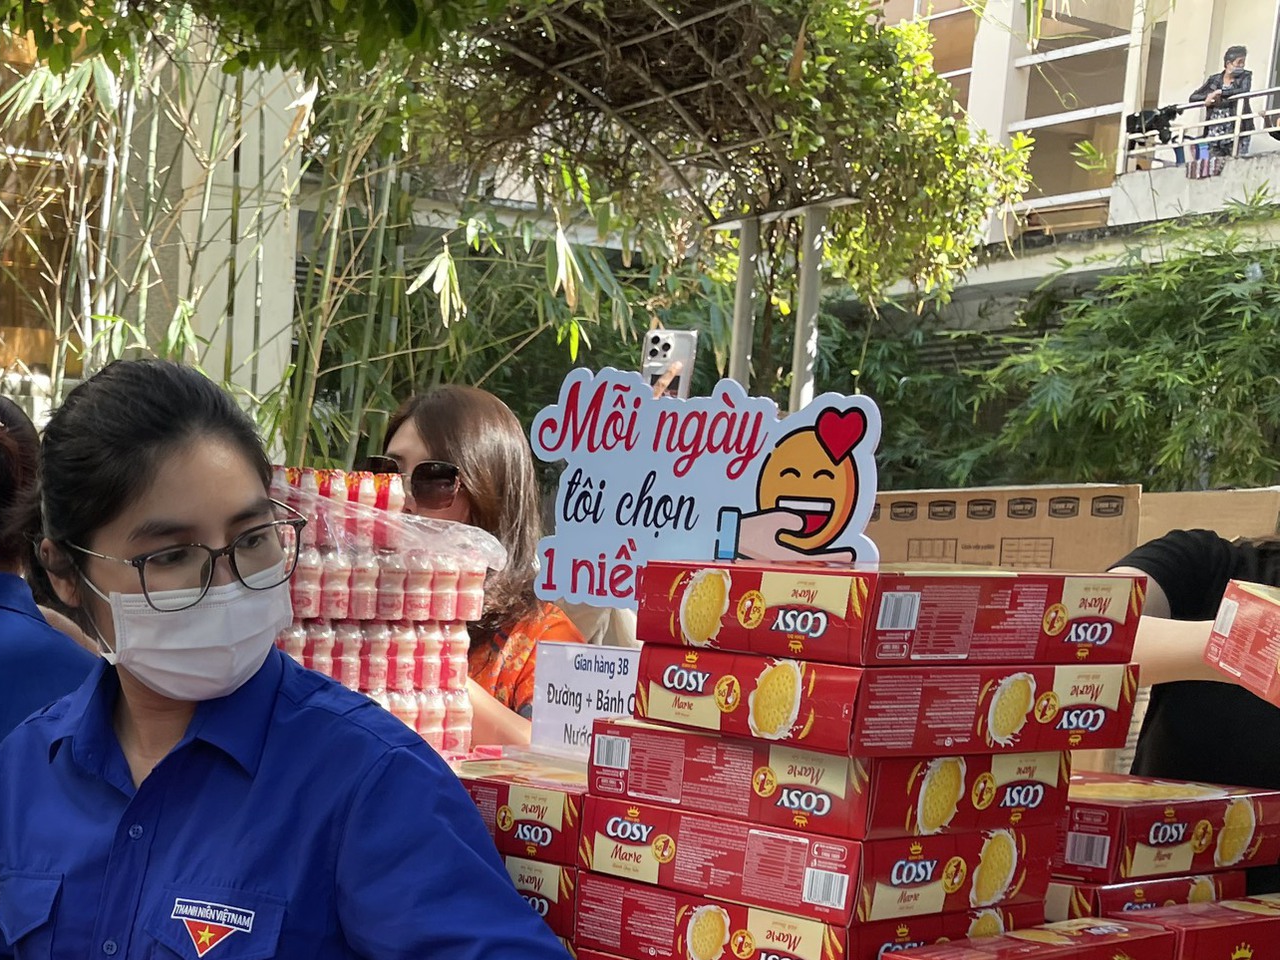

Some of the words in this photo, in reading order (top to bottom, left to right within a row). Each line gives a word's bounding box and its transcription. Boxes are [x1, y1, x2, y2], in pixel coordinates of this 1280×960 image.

[538, 380, 641, 454] Mỗi
[652, 392, 768, 480] ngày
[562, 468, 605, 523] tôi
[616, 470, 699, 538] chọn
[541, 548, 557, 591] 1
[571, 538, 648, 600] niề
[772, 609, 827, 637] COSY
[1064, 622, 1113, 645] COSY
[574, 654, 593, 671] Gian
[594, 655, 615, 679] hàng
[617, 658, 629, 675] 3B
[662, 665, 710, 692] COSY
[547, 684, 582, 714] Đường
[596, 689, 624, 714] Bánh
[1056, 709, 1105, 731] COSY
[776, 789, 831, 816] COSY
[1000, 784, 1044, 807] COSY
[514, 824, 552, 846] COSY
[606, 817, 654, 842] COSY
[1149, 822, 1188, 845] COSY
[891, 860, 938, 885] COSY
[230, 913, 251, 927] NAM
